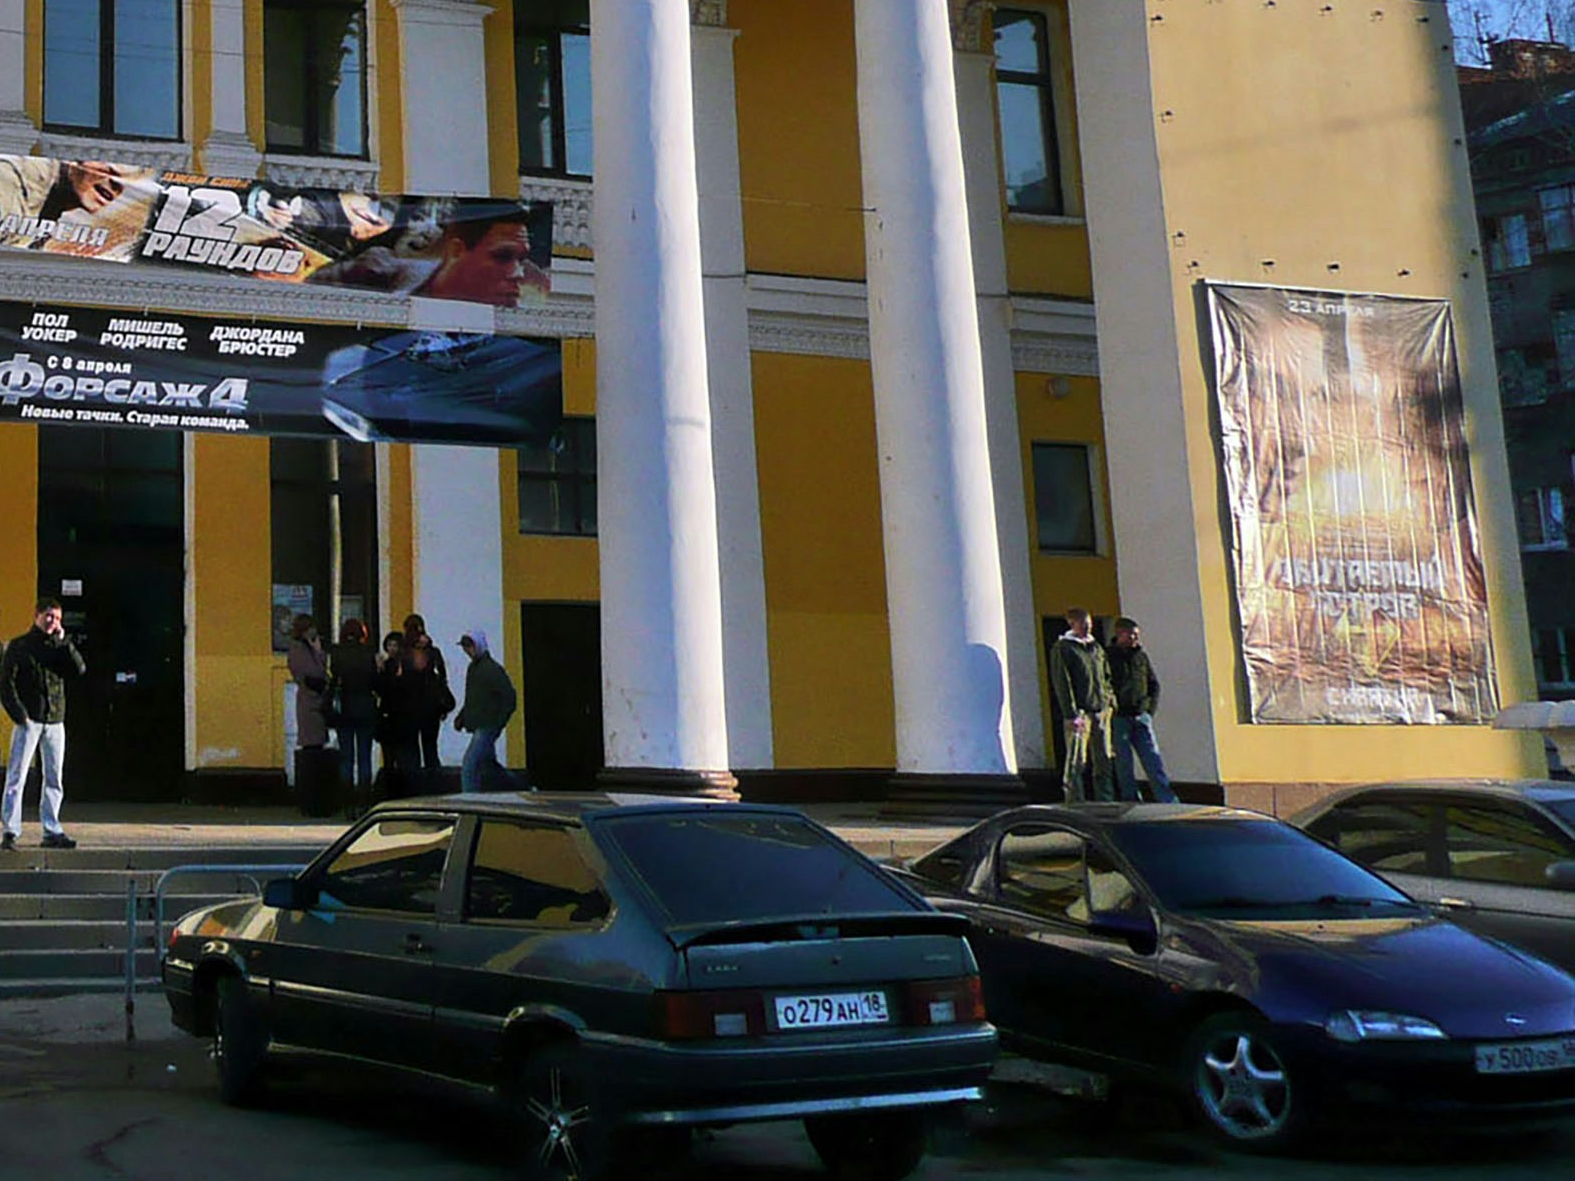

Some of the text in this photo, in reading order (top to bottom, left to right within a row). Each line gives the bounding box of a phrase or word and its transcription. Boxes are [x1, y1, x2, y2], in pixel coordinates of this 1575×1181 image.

[153, 185, 243, 242] 12
[0, 212, 110, 247] АПРЕЛЯ
[142, 231, 305, 274] РАУНДОВ
[1288, 300, 1376, 317] 23 АПРЛЯ
[31, 313, 70, 328] ПОЛ
[108, 318, 185, 336] МИШЕЛЬ
[21, 326, 78, 342] УОКЕР
[99, 332, 188, 350] РОДРИГЕС
[209, 325, 305, 344] ДЖОРДАНА
[218, 340, 297, 357] БРЮСТЕР
[47, 355, 132, 374] С 8 апреля
[208, 377, 250, 413] 4
[21, 404, 250, 431] Новые тачки. Старая команда.
